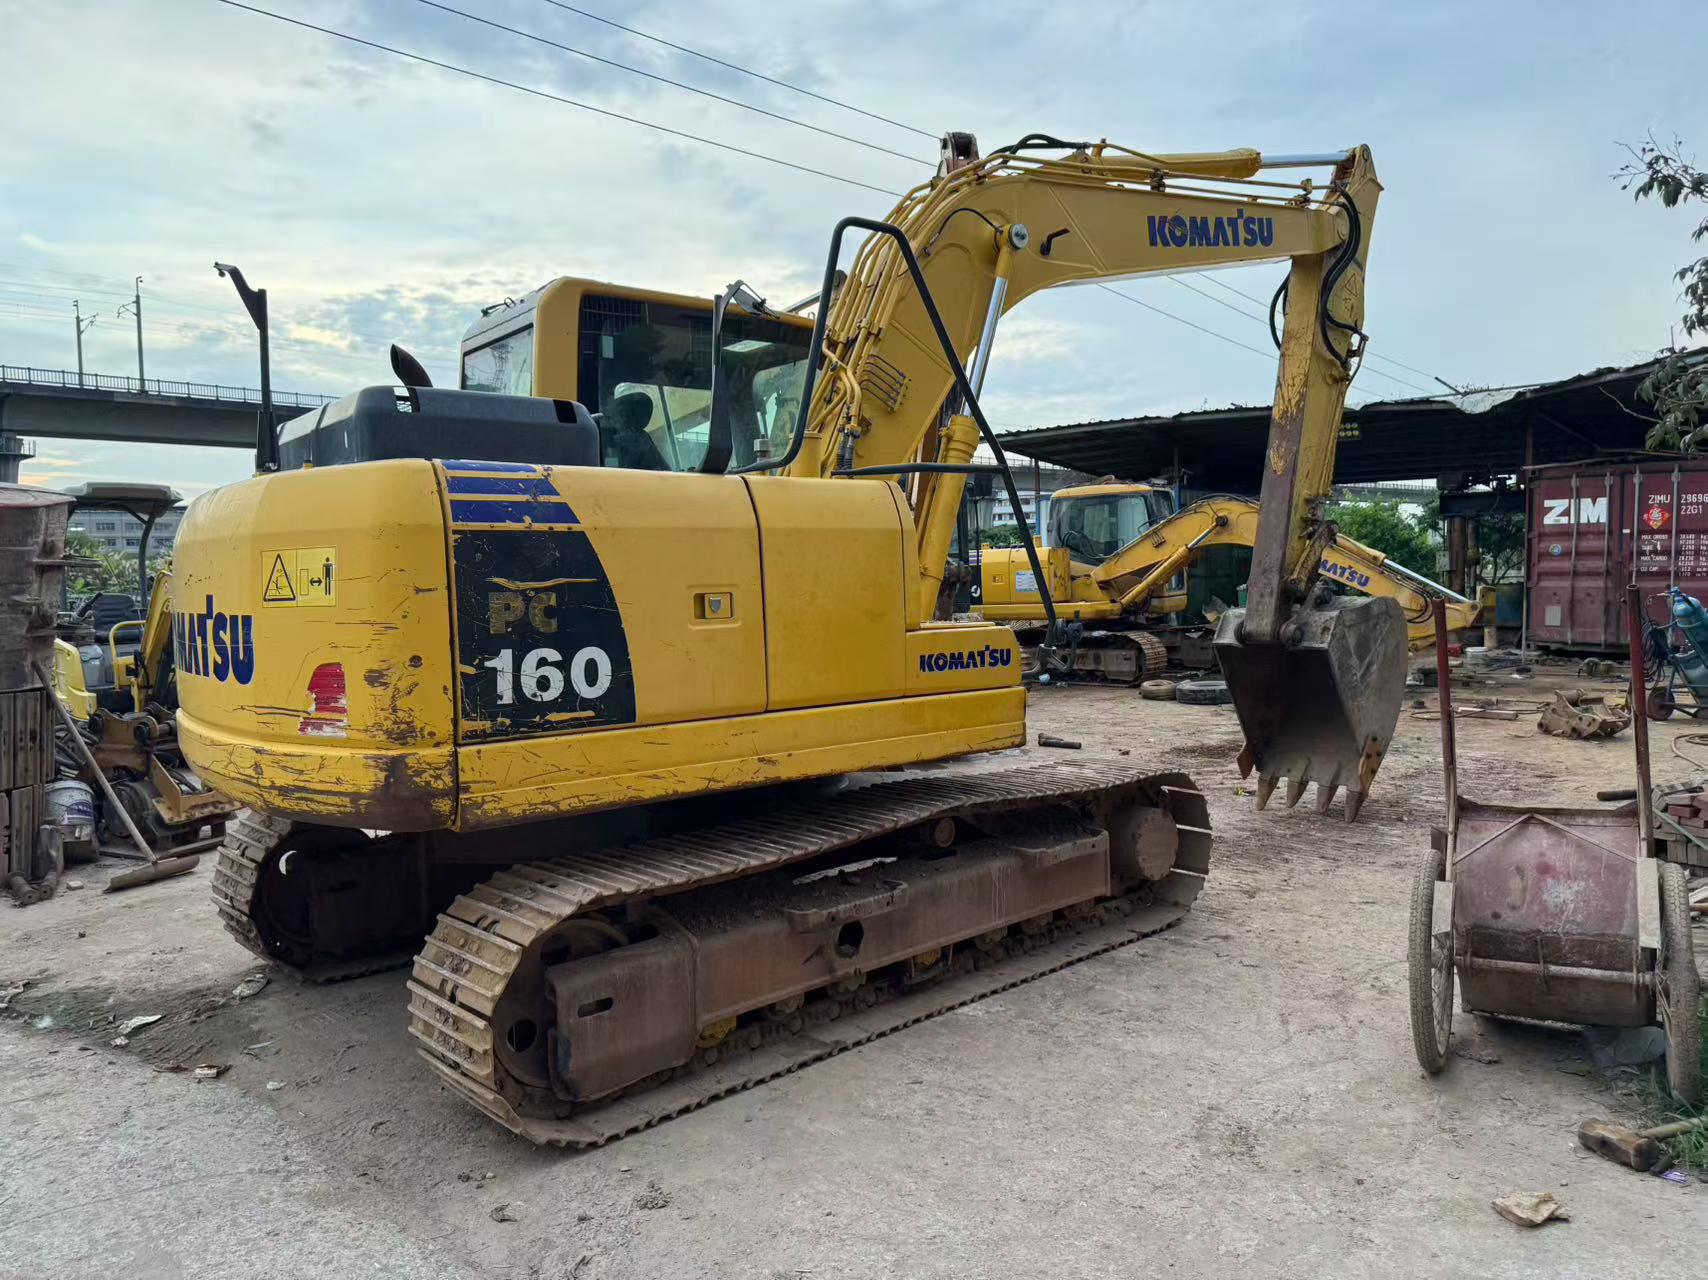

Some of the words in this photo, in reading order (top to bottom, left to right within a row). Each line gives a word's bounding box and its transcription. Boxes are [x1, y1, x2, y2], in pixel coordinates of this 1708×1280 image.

[1146, 208, 1273, 247] KOMATSU
[1543, 497, 1608, 524] ZIM
[1648, 494, 1671, 504] ZIMU
[488, 591, 559, 635] PC
[484, 646, 612, 705] 160
[919, 645, 1012, 673] KOMATSU
